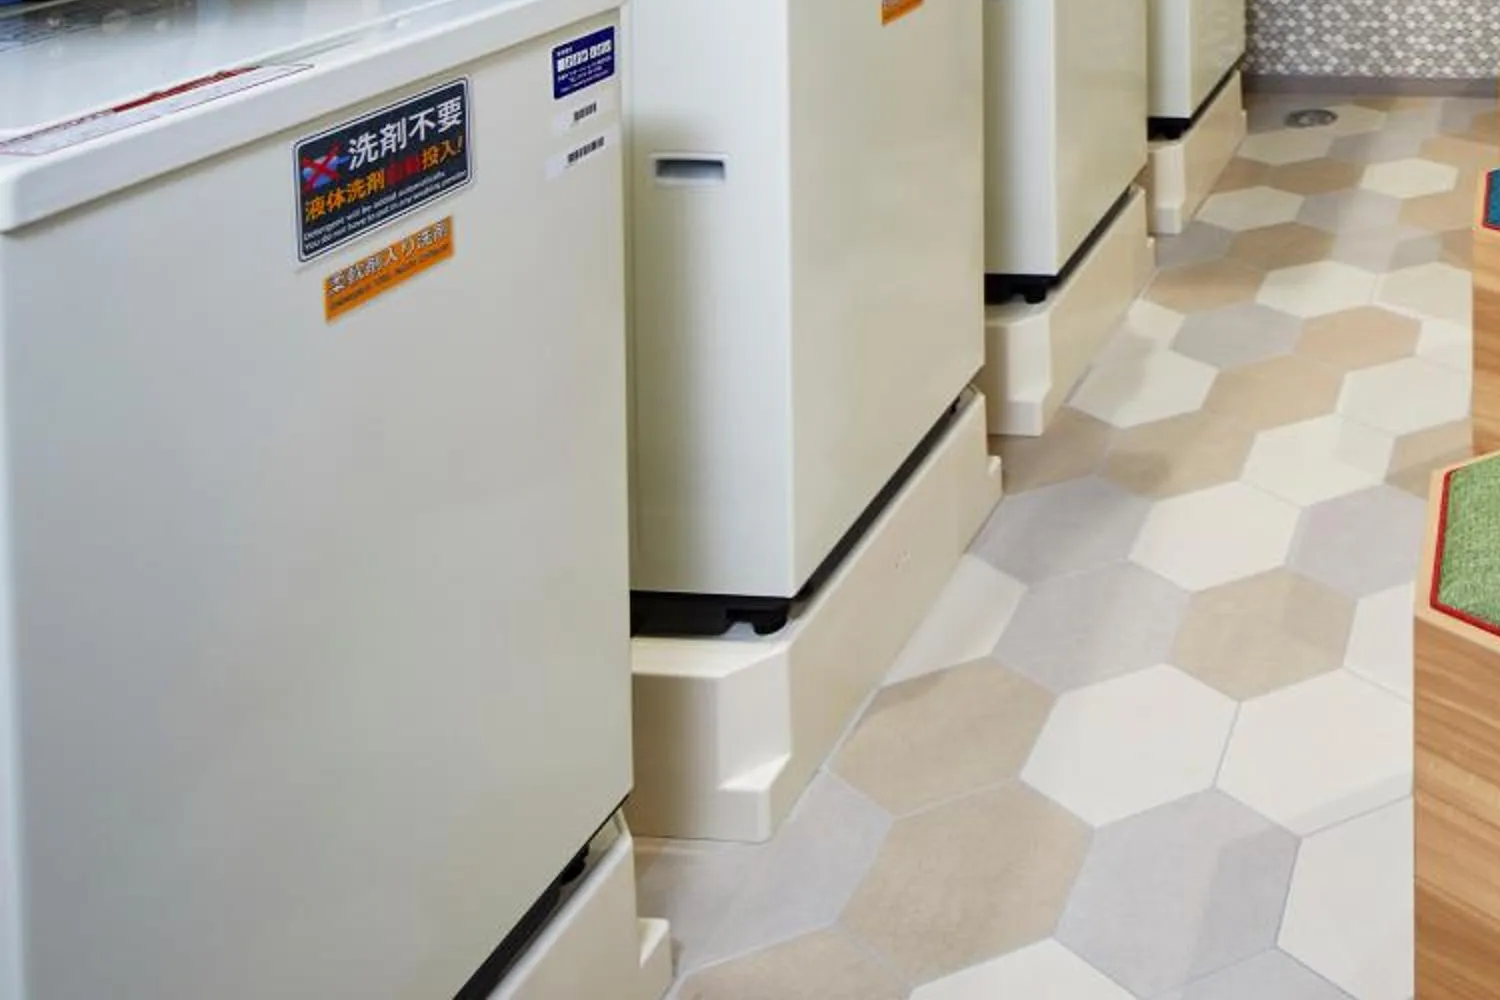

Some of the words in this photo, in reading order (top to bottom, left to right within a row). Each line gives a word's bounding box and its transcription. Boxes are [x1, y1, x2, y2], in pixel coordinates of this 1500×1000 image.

[348, 94, 463, 172] 洗剤不要
[304, 134, 464, 223] 液体洗剤投入!
